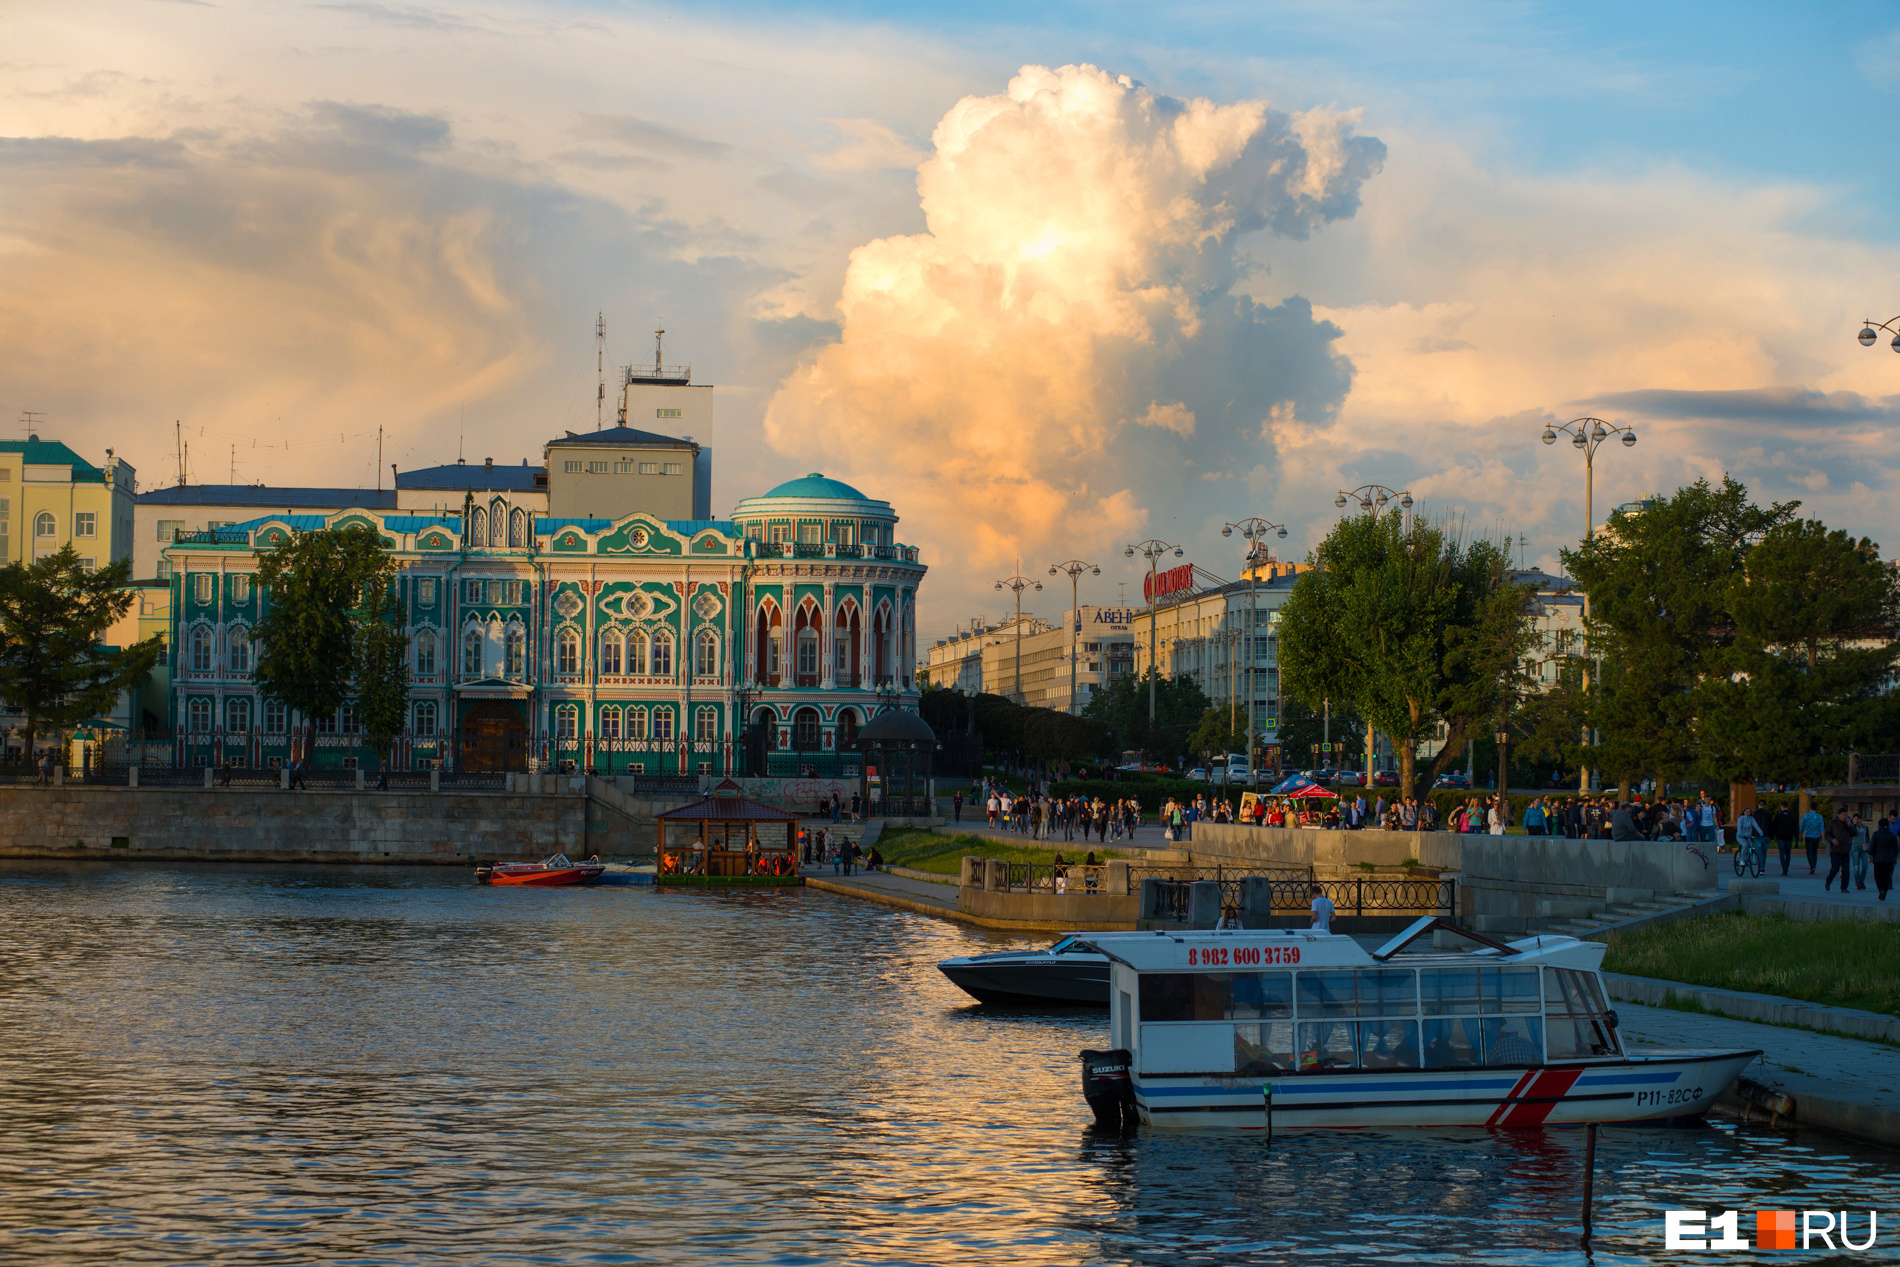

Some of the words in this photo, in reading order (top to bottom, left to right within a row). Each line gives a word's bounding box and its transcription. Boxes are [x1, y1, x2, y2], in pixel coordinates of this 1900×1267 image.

[1166, 563, 1193, 594] MOTORS
[1188, 948, 1198, 966] 8
[1201, 947, 1229, 966] 982
[1233, 947, 1261, 965] 600
[1264, 946, 1301, 965] 3759
[1091, 1064, 1125, 1074] SUZUKI
